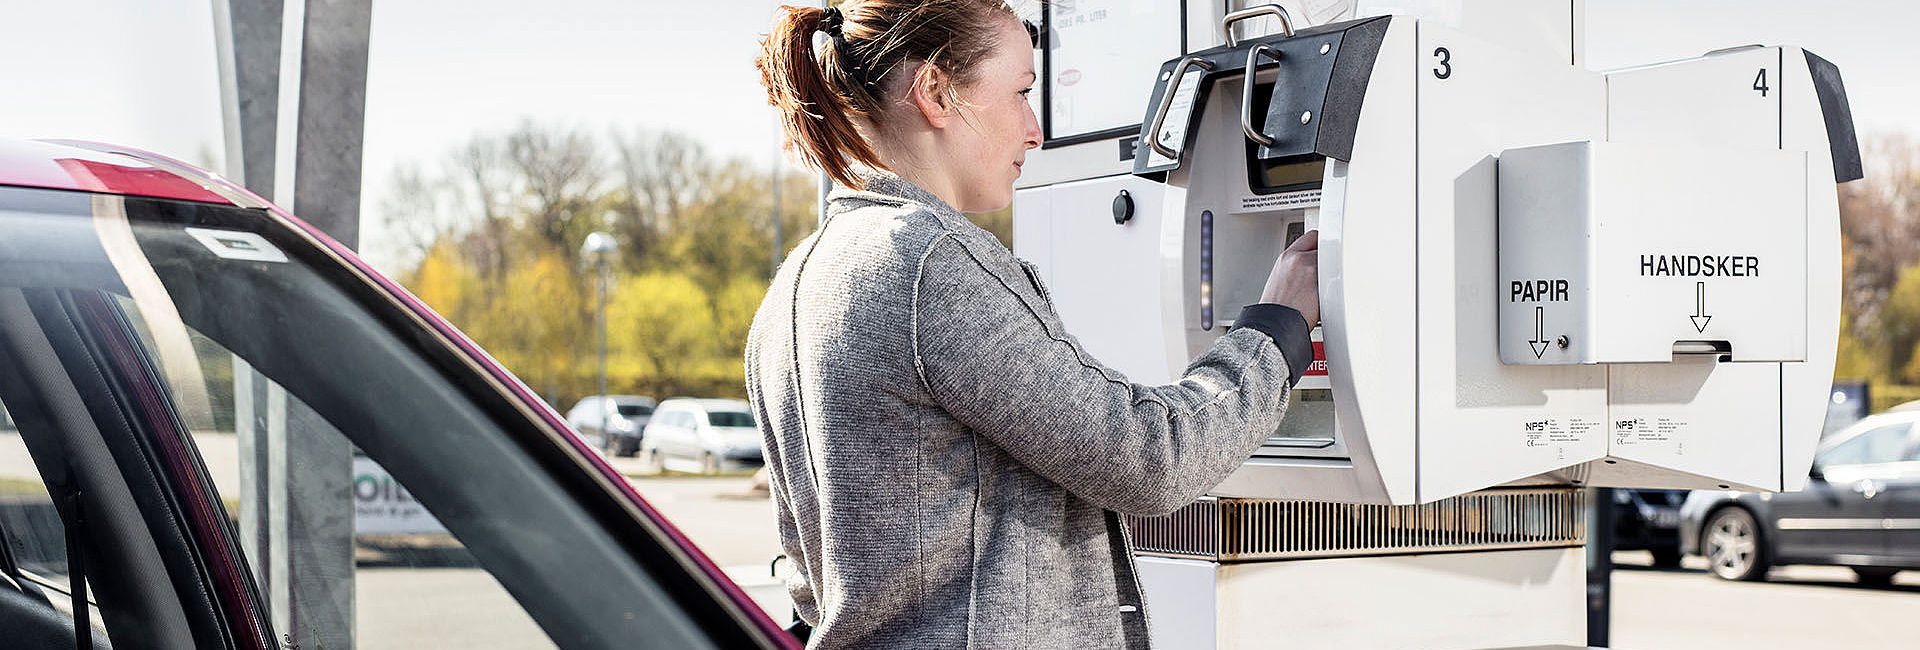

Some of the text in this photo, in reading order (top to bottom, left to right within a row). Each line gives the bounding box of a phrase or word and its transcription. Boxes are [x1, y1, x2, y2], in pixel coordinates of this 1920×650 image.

[1433, 46, 1451, 79] 3
[1753, 68, 1769, 97] 4
[1640, 254, 1759, 277] HANDSKER
[1511, 279, 1569, 302] PAPIR
[1307, 360, 1328, 371] NTER
[1525, 422, 1544, 431] NPS
[1615, 420, 1634, 430] NPS
